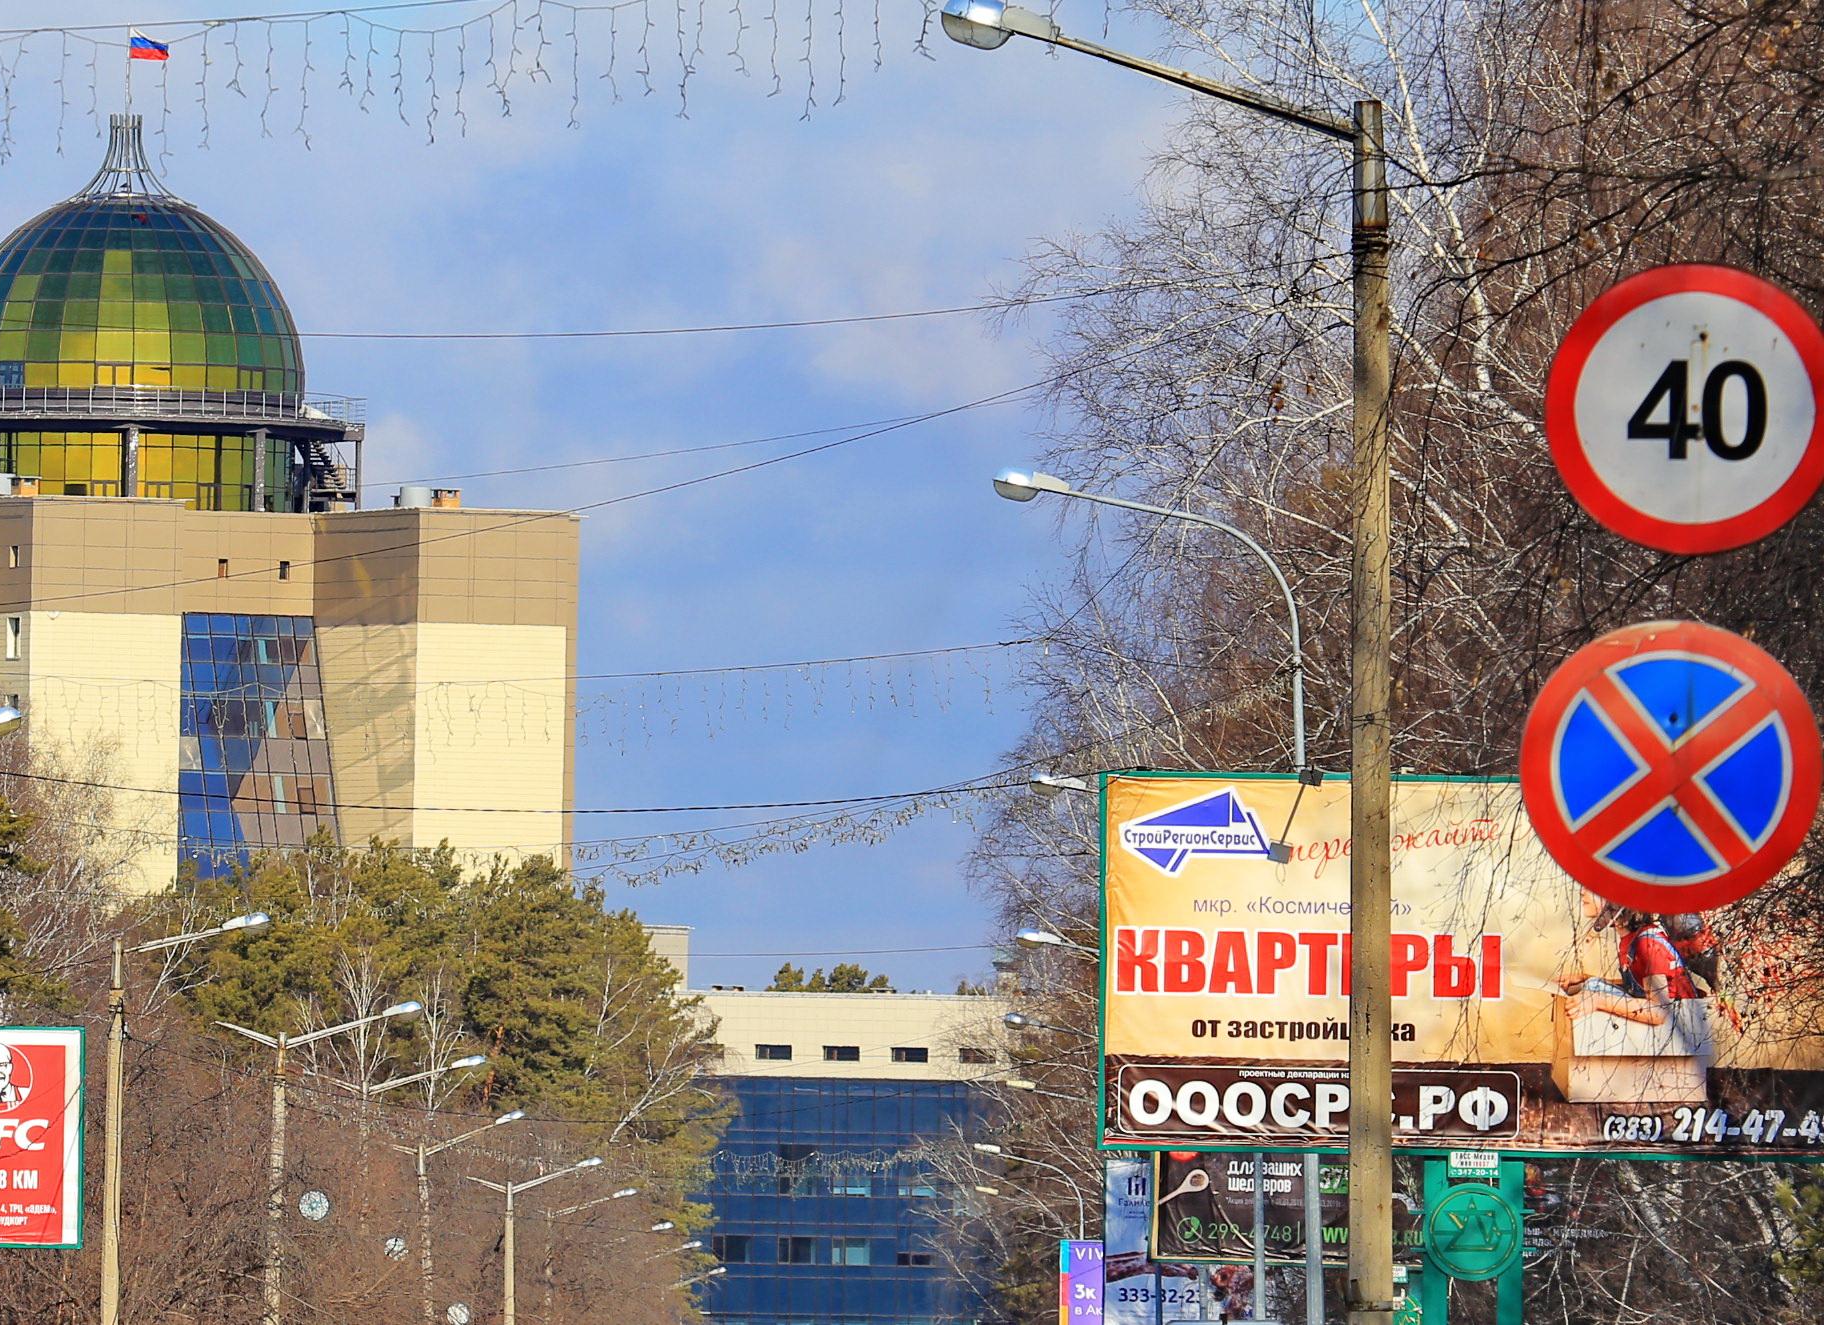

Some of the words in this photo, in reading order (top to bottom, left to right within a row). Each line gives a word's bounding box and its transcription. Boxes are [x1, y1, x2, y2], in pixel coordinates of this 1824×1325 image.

[1627, 359, 1768, 461] 40
[1124, 829, 1256, 847] СтройРегионСервис
[1193, 899, 1236, 917] мкр.
[1246, 896, 1412, 916] «Космичей»
[1191, 1018, 1219, 1039] от
[1238, 1070, 1285, 1079] проектные
[1287, 1070, 1340, 1079] декларации
[1128, 1078, 1509, 1131] ОООСР.РФ
[1603, 1115, 1662, 1142] (383)
[1672, 1107, 1824, 1144] 214-47-4
[13, 1170, 38, 1189] КМ
[1228, 1178, 1292, 1196] шедвров
